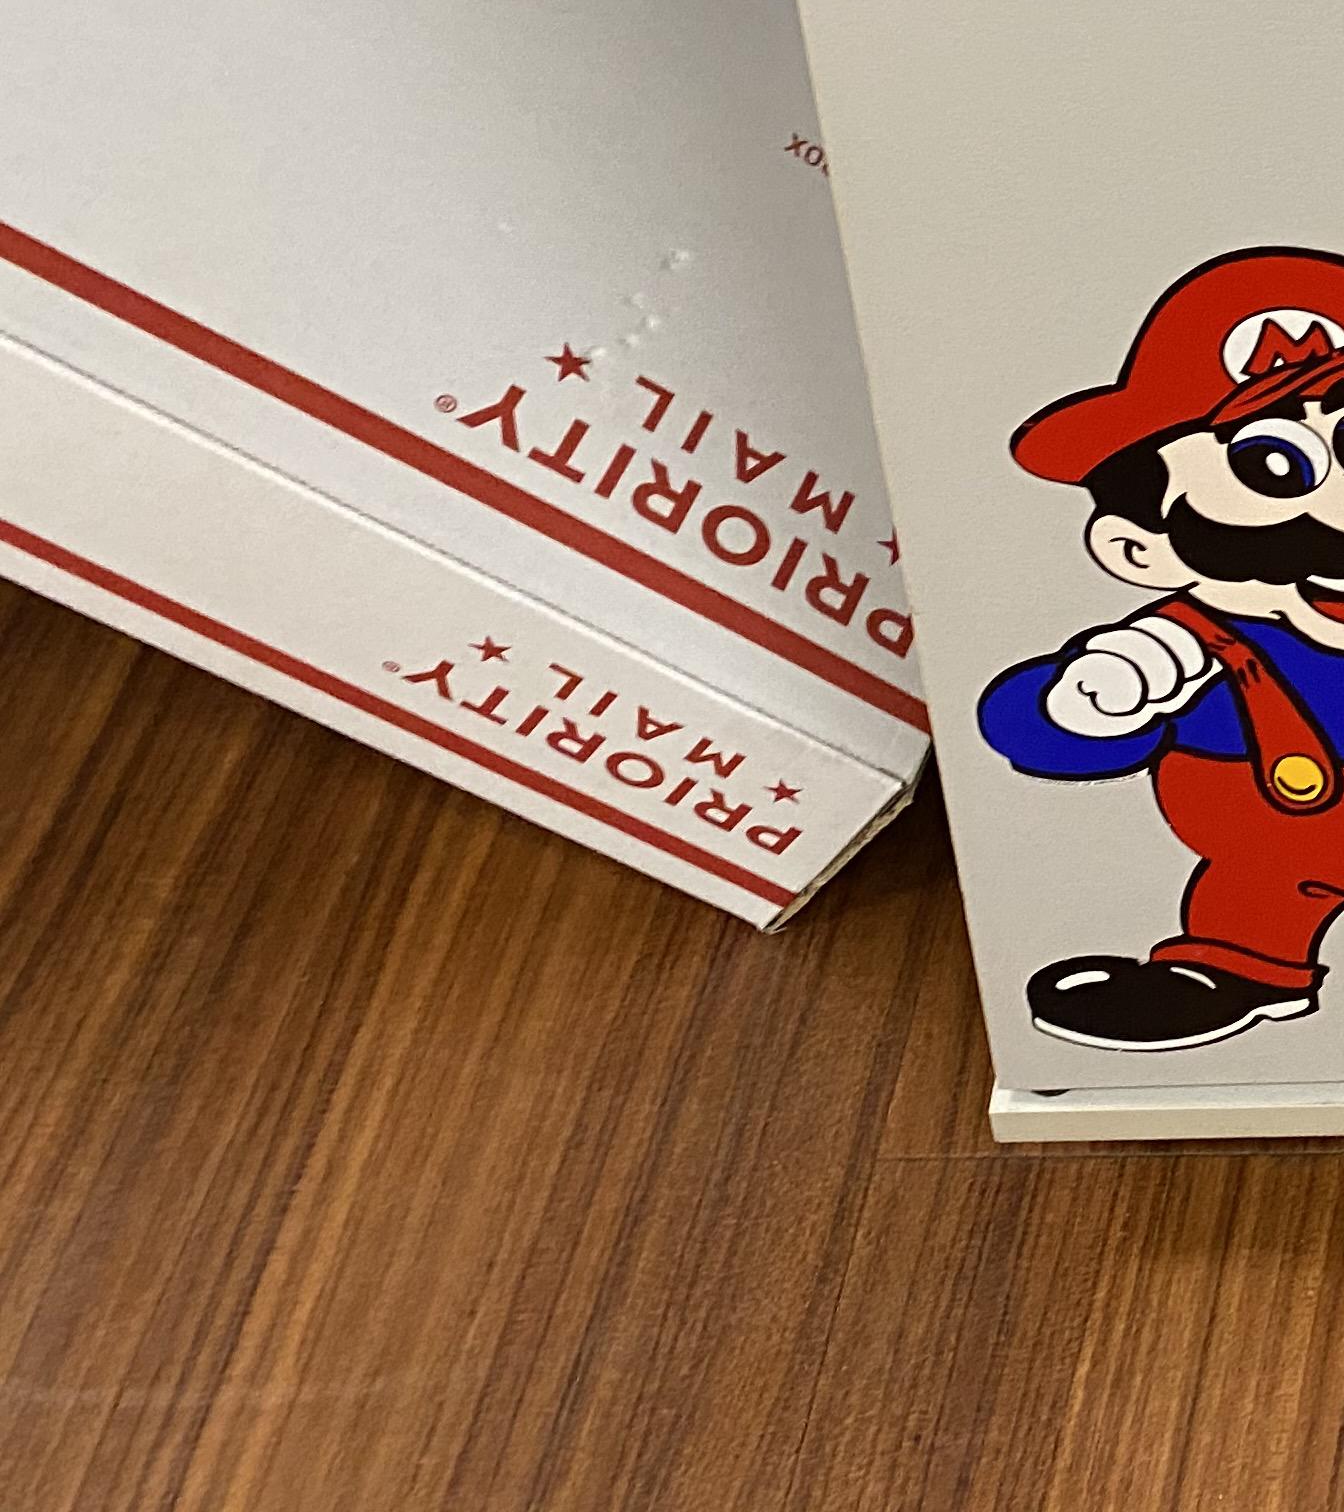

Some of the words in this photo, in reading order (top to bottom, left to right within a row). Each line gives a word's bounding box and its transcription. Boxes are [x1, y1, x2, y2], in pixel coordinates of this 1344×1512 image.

[784, 132, 830, 176] OX
[1238, 317, 1338, 375] M
[456, 383, 916, 660] PRIORITY
[634, 373, 857, 536] MAIL
[400, 658, 806, 856] PRIORITY
[548, 661, 748, 779] MAIL
